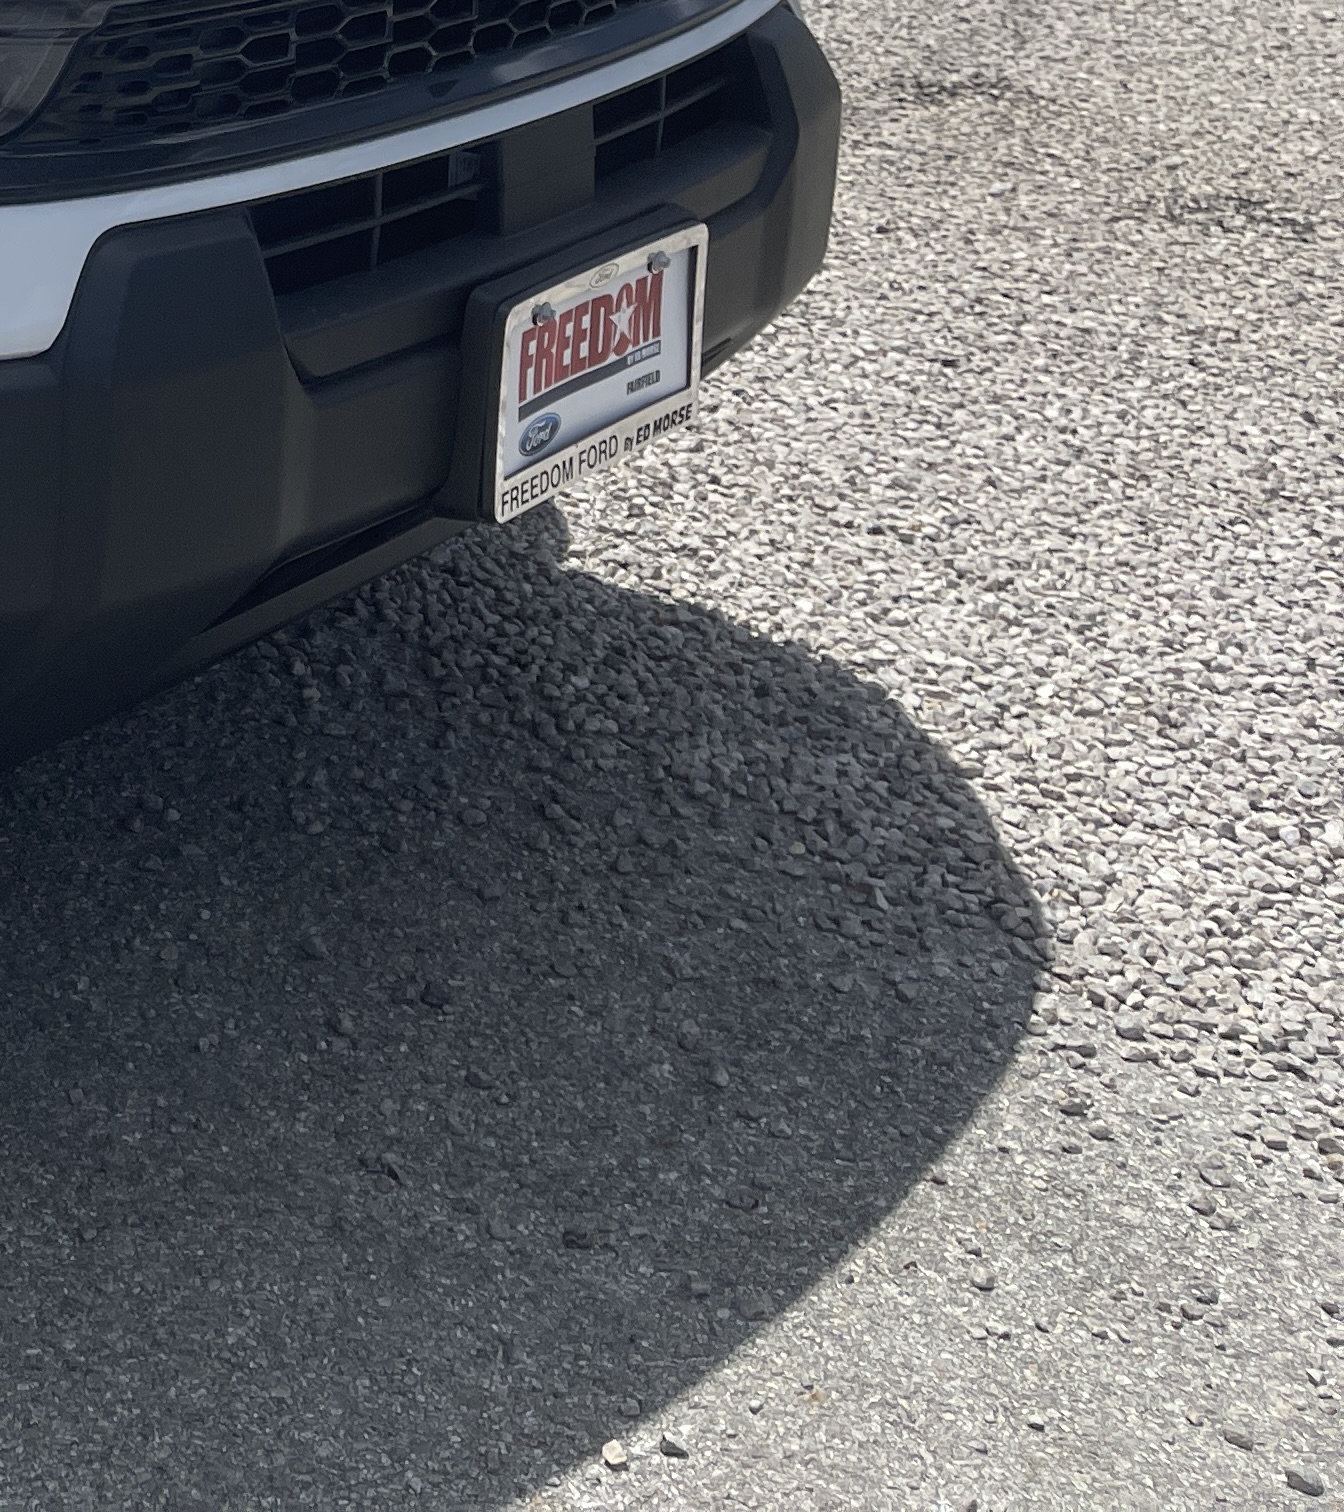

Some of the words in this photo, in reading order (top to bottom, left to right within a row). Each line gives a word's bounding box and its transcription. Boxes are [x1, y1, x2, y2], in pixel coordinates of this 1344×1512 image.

[518, 272, 662, 404] FREEDOM
[501, 456, 574, 518] FREEDOM
[578, 435, 619, 476] FORD
[624, 436, 634, 453] BY
[636, 422, 651, 446] ED
[652, 402, 694, 439] MORSE
[525, 419, 553, 451] Ford
